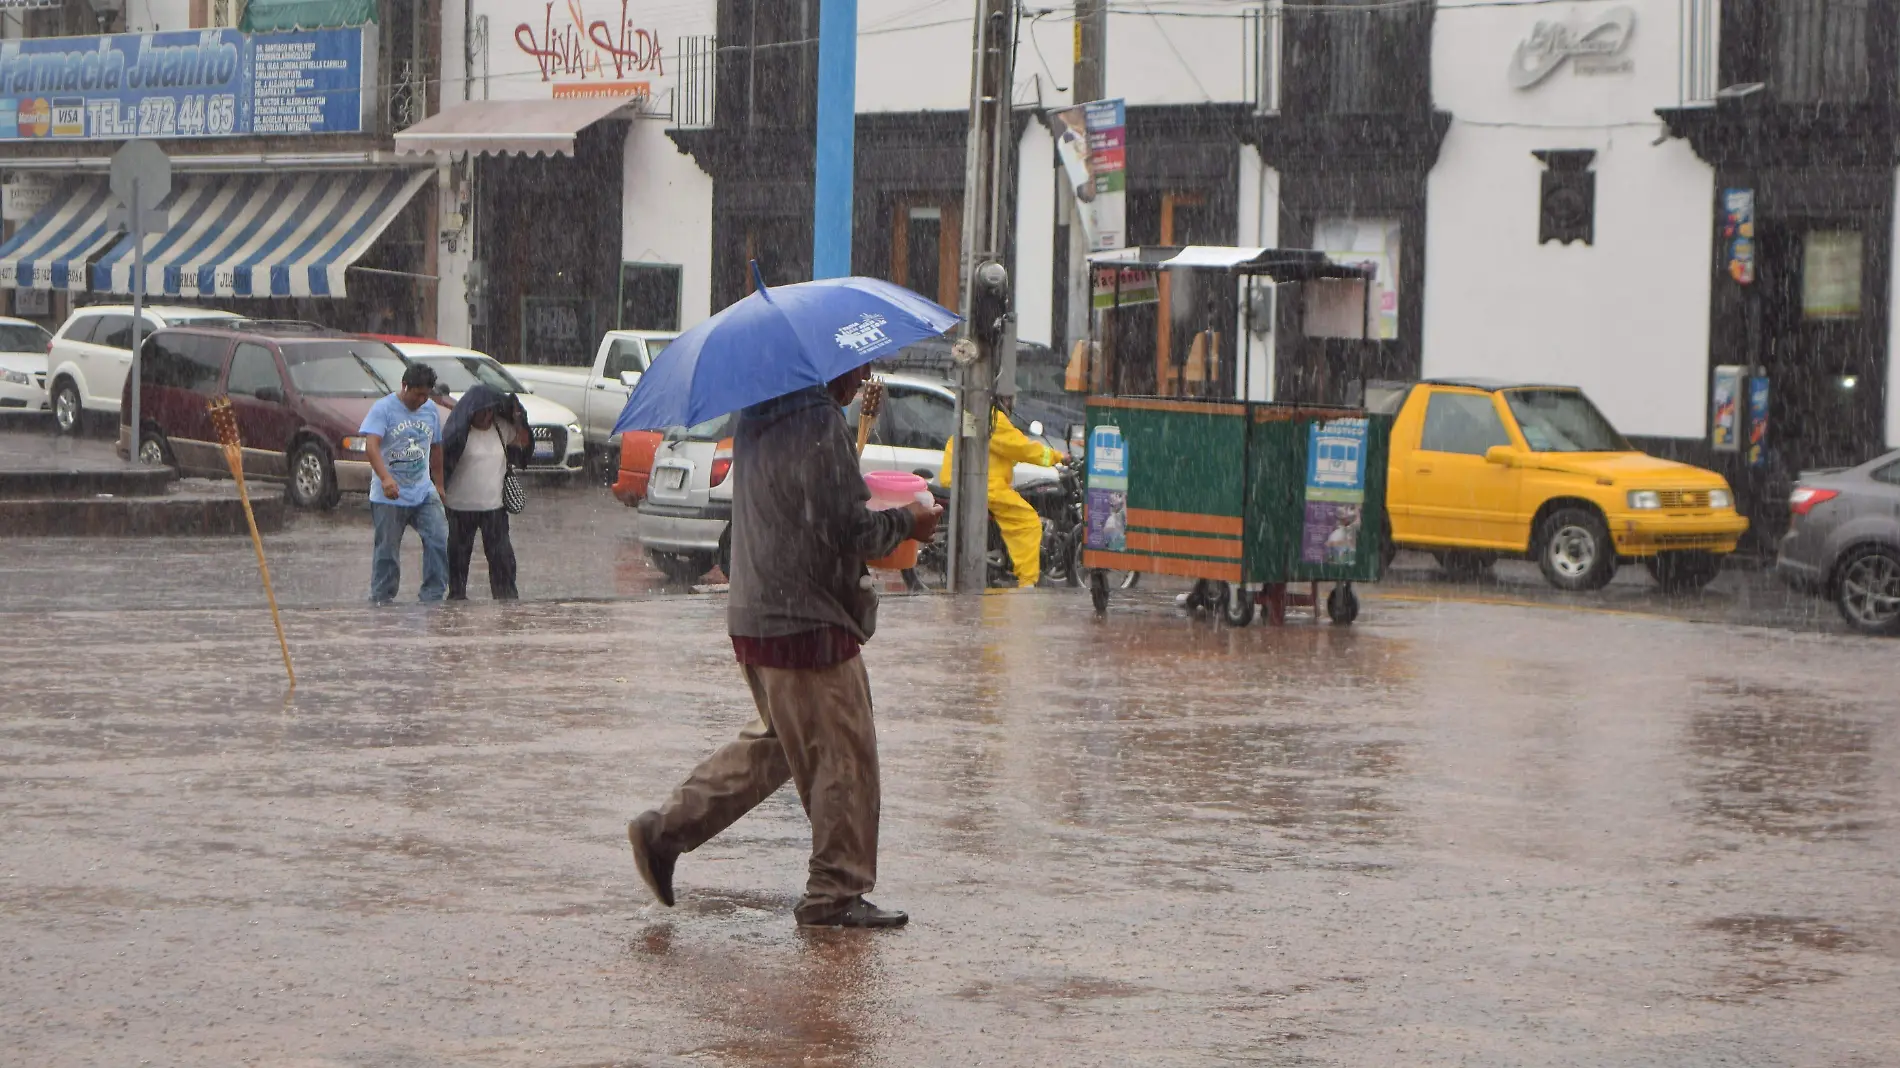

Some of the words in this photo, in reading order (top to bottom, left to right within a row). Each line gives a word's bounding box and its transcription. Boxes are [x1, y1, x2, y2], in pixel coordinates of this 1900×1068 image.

[127, 27, 237, 87] Juanito
[59, 109, 79, 124] VISA
[138, 96, 176, 137] 272
[178, 93, 204, 137] 44
[207, 93, 235, 137] 65
